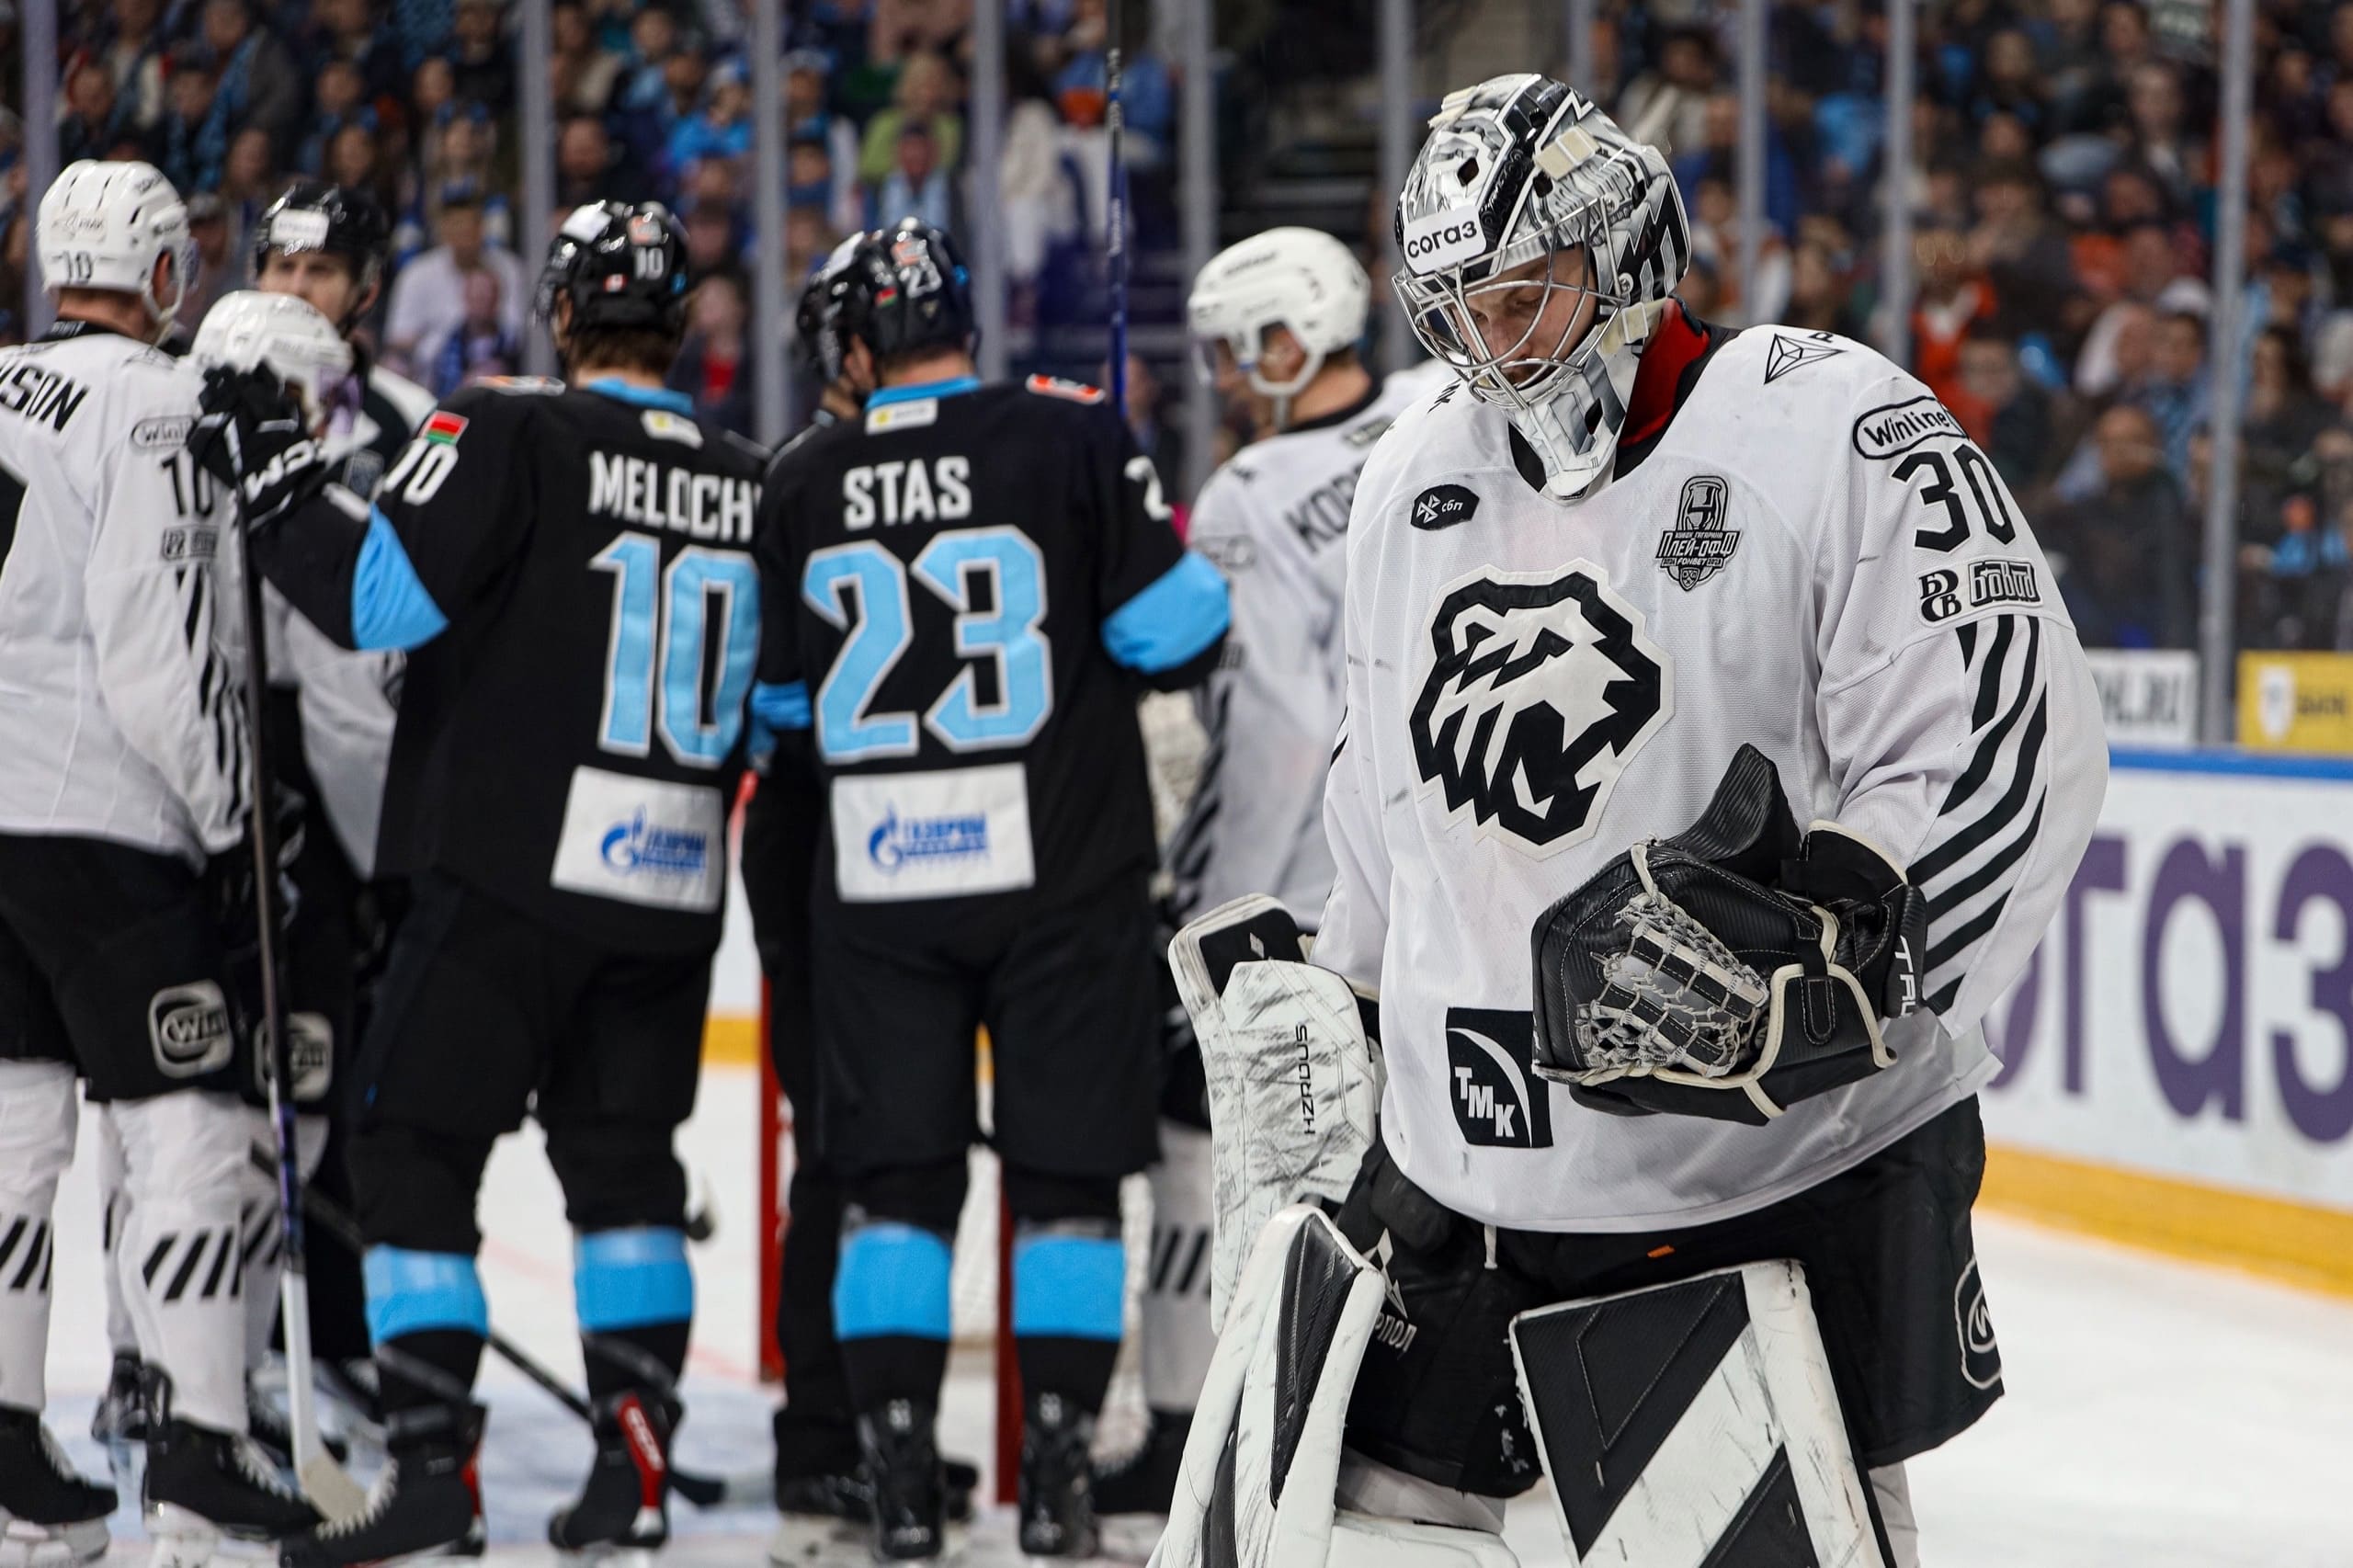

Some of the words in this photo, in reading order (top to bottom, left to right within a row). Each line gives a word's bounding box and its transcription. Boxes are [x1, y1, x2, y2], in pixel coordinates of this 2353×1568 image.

[1406, 219, 1478, 258] согаз
[1863, 411, 1950, 448] Winline
[162, 449, 213, 517] 10
[588, 450, 762, 542] MELOCH
[842, 455, 972, 531] STAS
[1440, 497, 1464, 514] сбп
[1890, 443, 2017, 553] 30
[587, 529, 762, 769] 10
[800, 523, 1054, 766] 23
